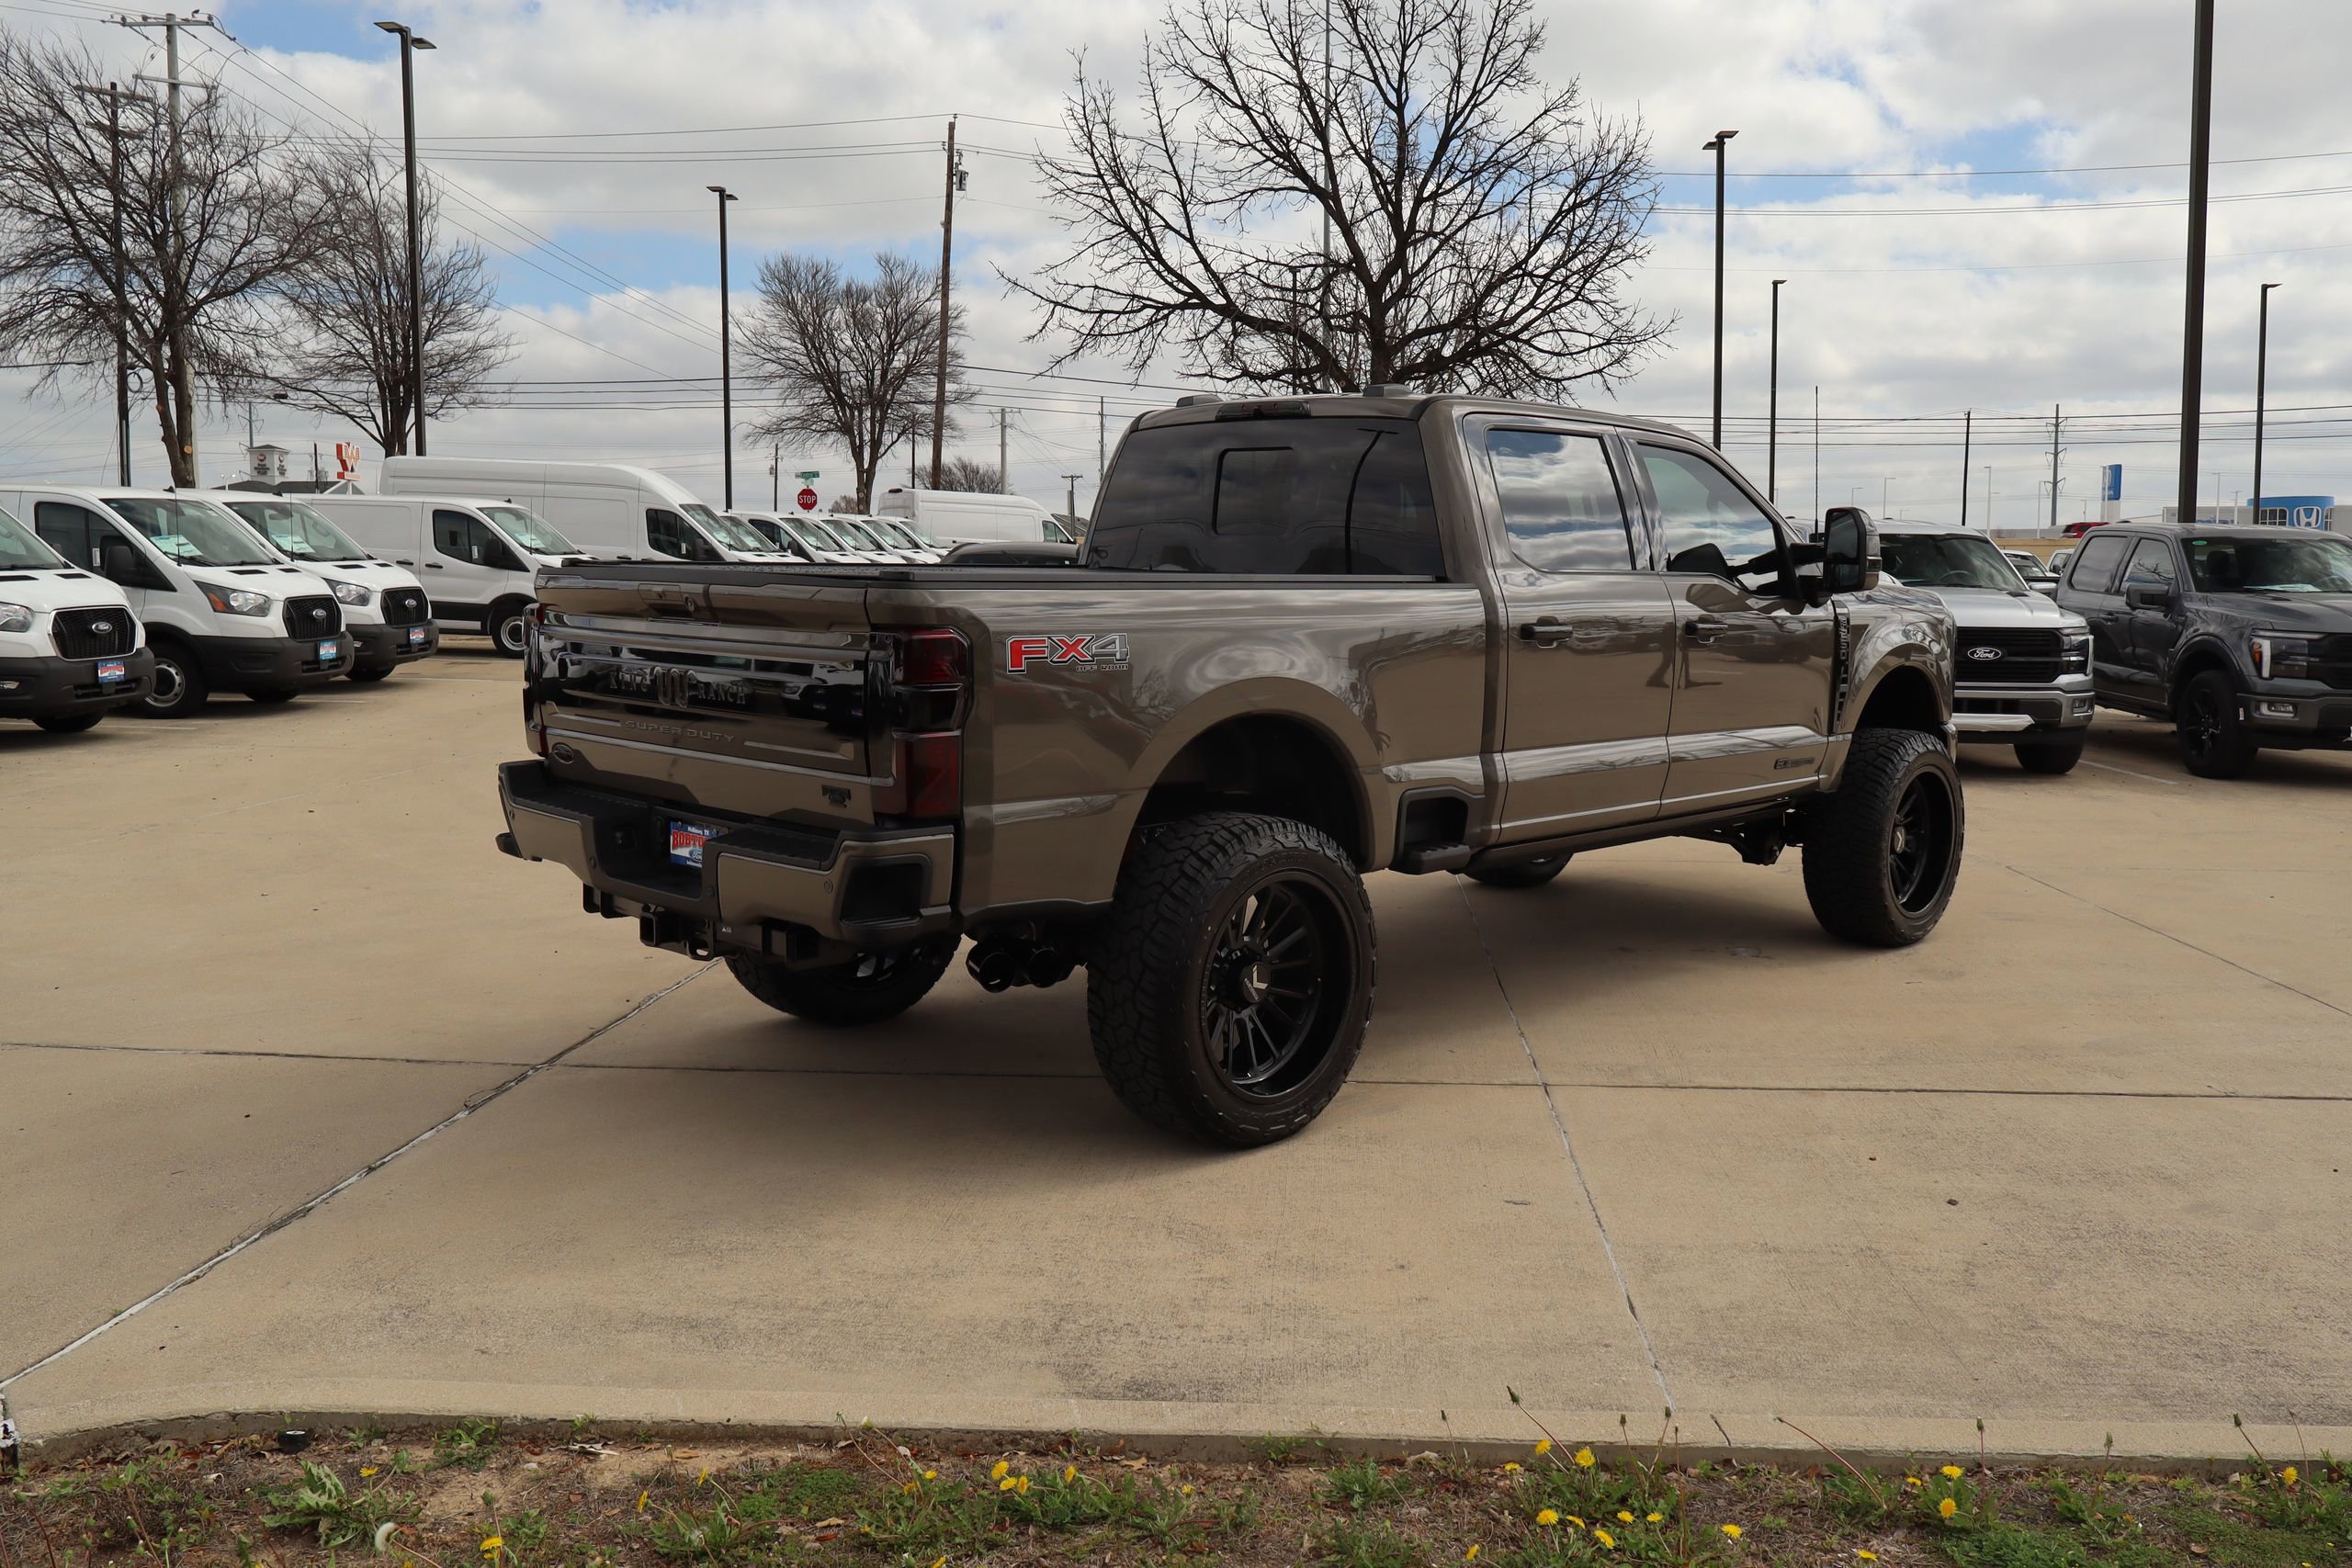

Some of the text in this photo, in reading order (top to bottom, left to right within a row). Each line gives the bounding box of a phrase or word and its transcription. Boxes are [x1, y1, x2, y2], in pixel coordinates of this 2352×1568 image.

[799, 495, 816, 503] STOP
[1006, 633, 1129, 674] FX4
[1974, 649, 1995, 659] Ford
[609, 671, 746, 705] KING RANCH
[625, 720, 735, 742] SUPER DUTY
